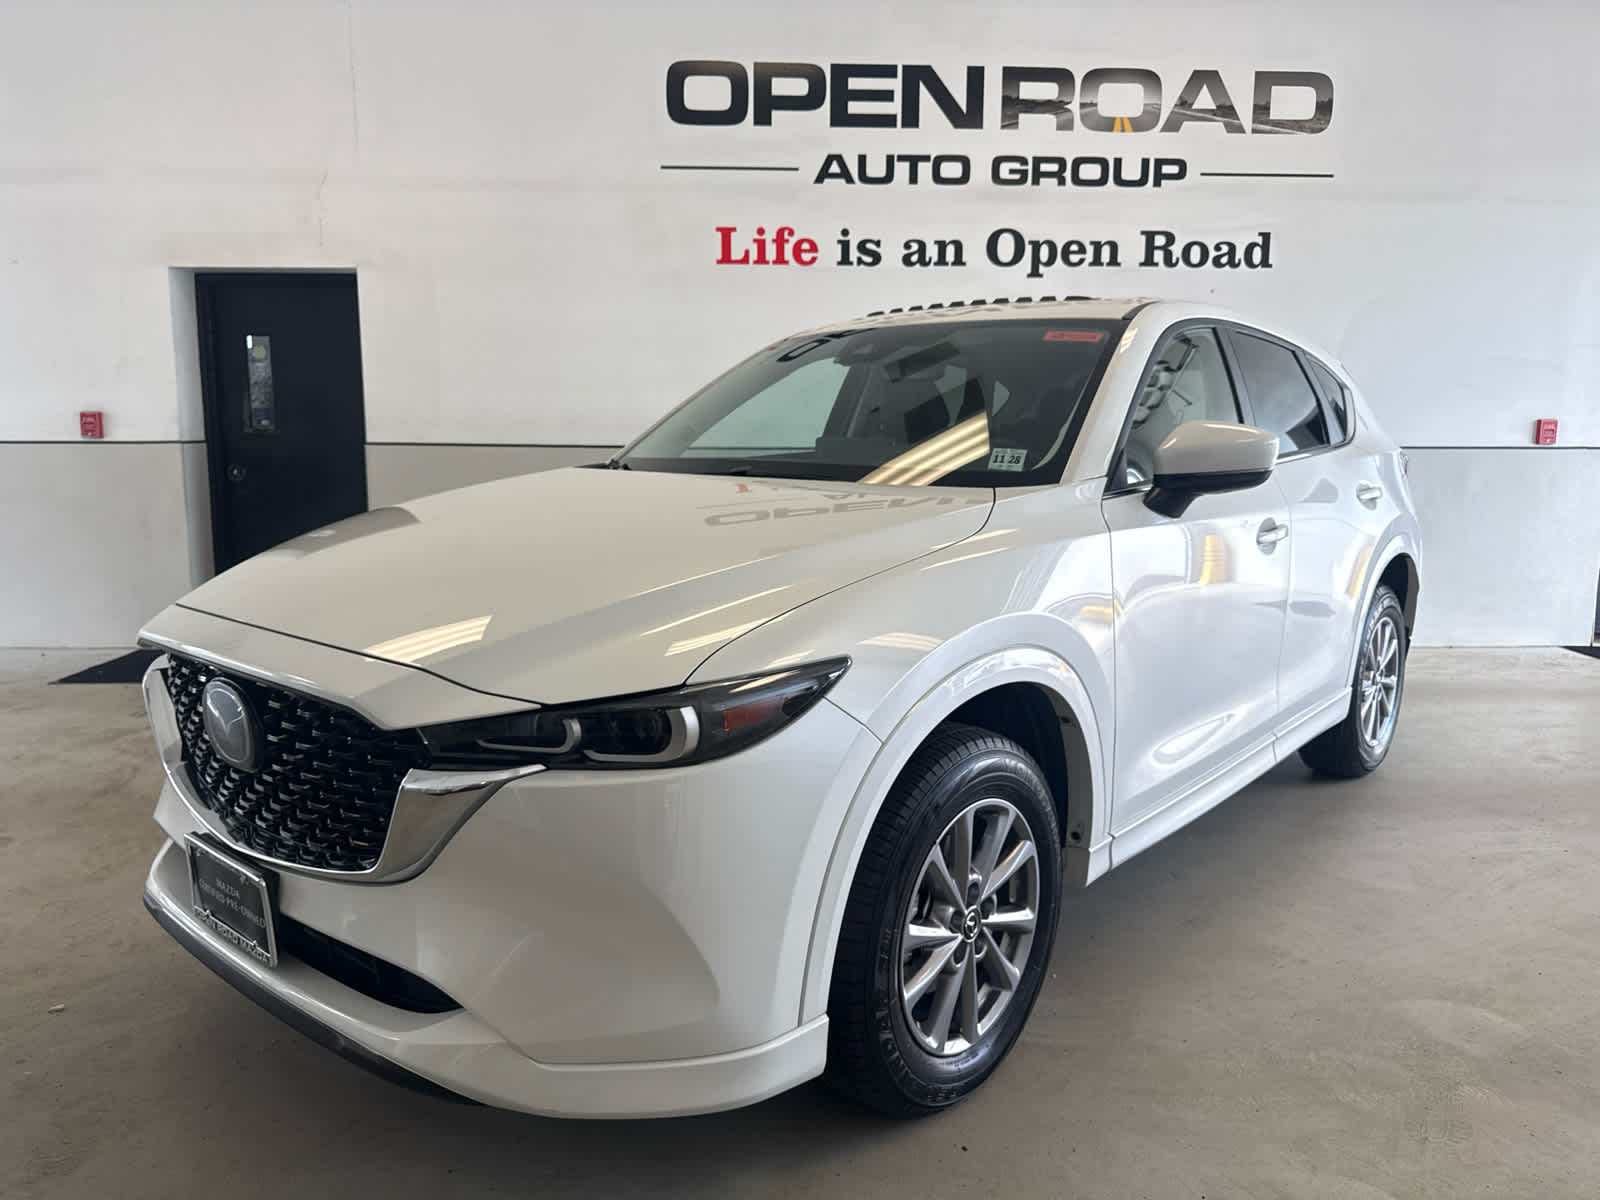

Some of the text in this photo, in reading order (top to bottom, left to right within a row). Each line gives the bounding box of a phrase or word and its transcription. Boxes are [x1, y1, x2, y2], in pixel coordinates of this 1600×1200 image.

[665, 60, 1335, 135] OPEN ROAD
[813, 153, 1188, 188] AUTO GROUP
[715, 226, 1274, 279] Life is an Open Road
[992, 454, 1022, 465] 11 28
